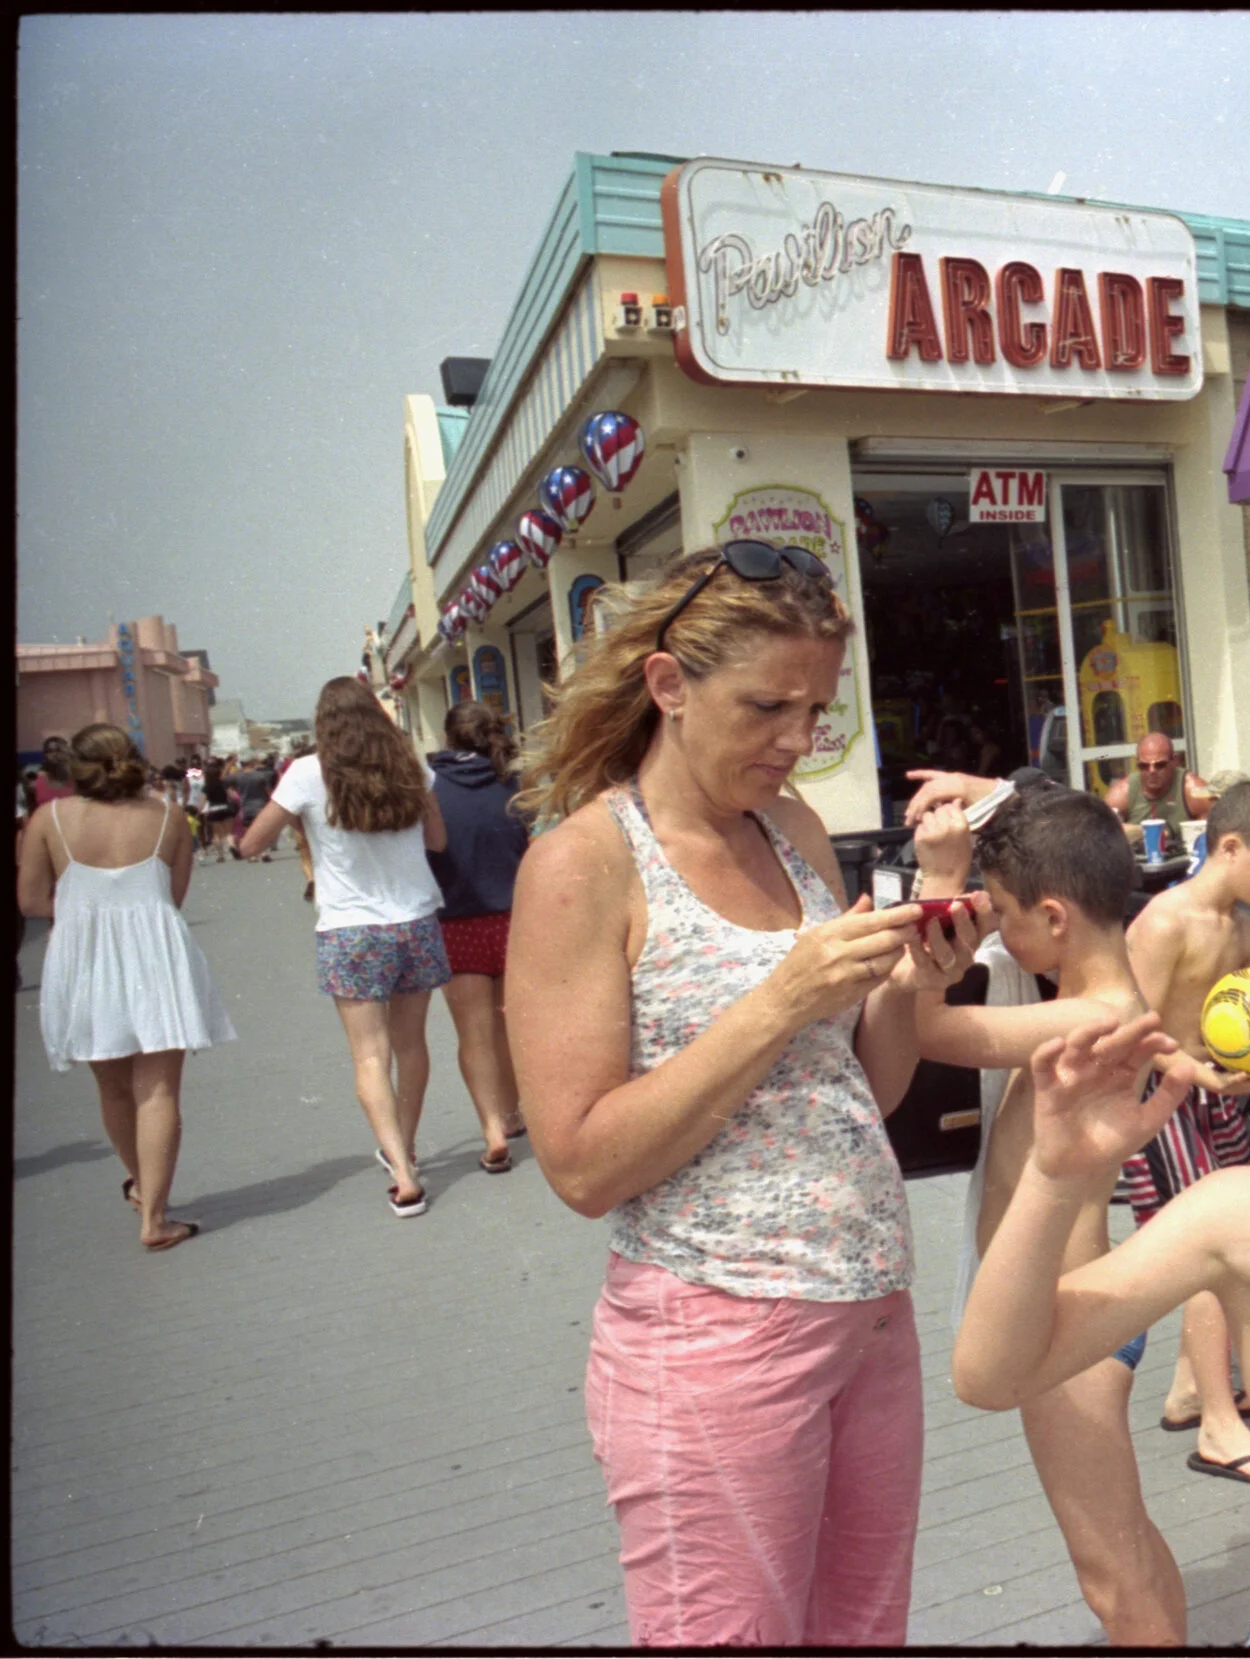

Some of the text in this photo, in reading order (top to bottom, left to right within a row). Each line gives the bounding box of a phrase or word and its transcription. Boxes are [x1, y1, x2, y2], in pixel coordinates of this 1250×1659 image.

[700, 201, 912, 336] Pavilion
[887, 251, 1192, 375] ARCADE
[971, 471, 1044, 506] ATM
[729, 507, 832, 540] PAVILION
[979, 510, 1036, 520] INSIDE
